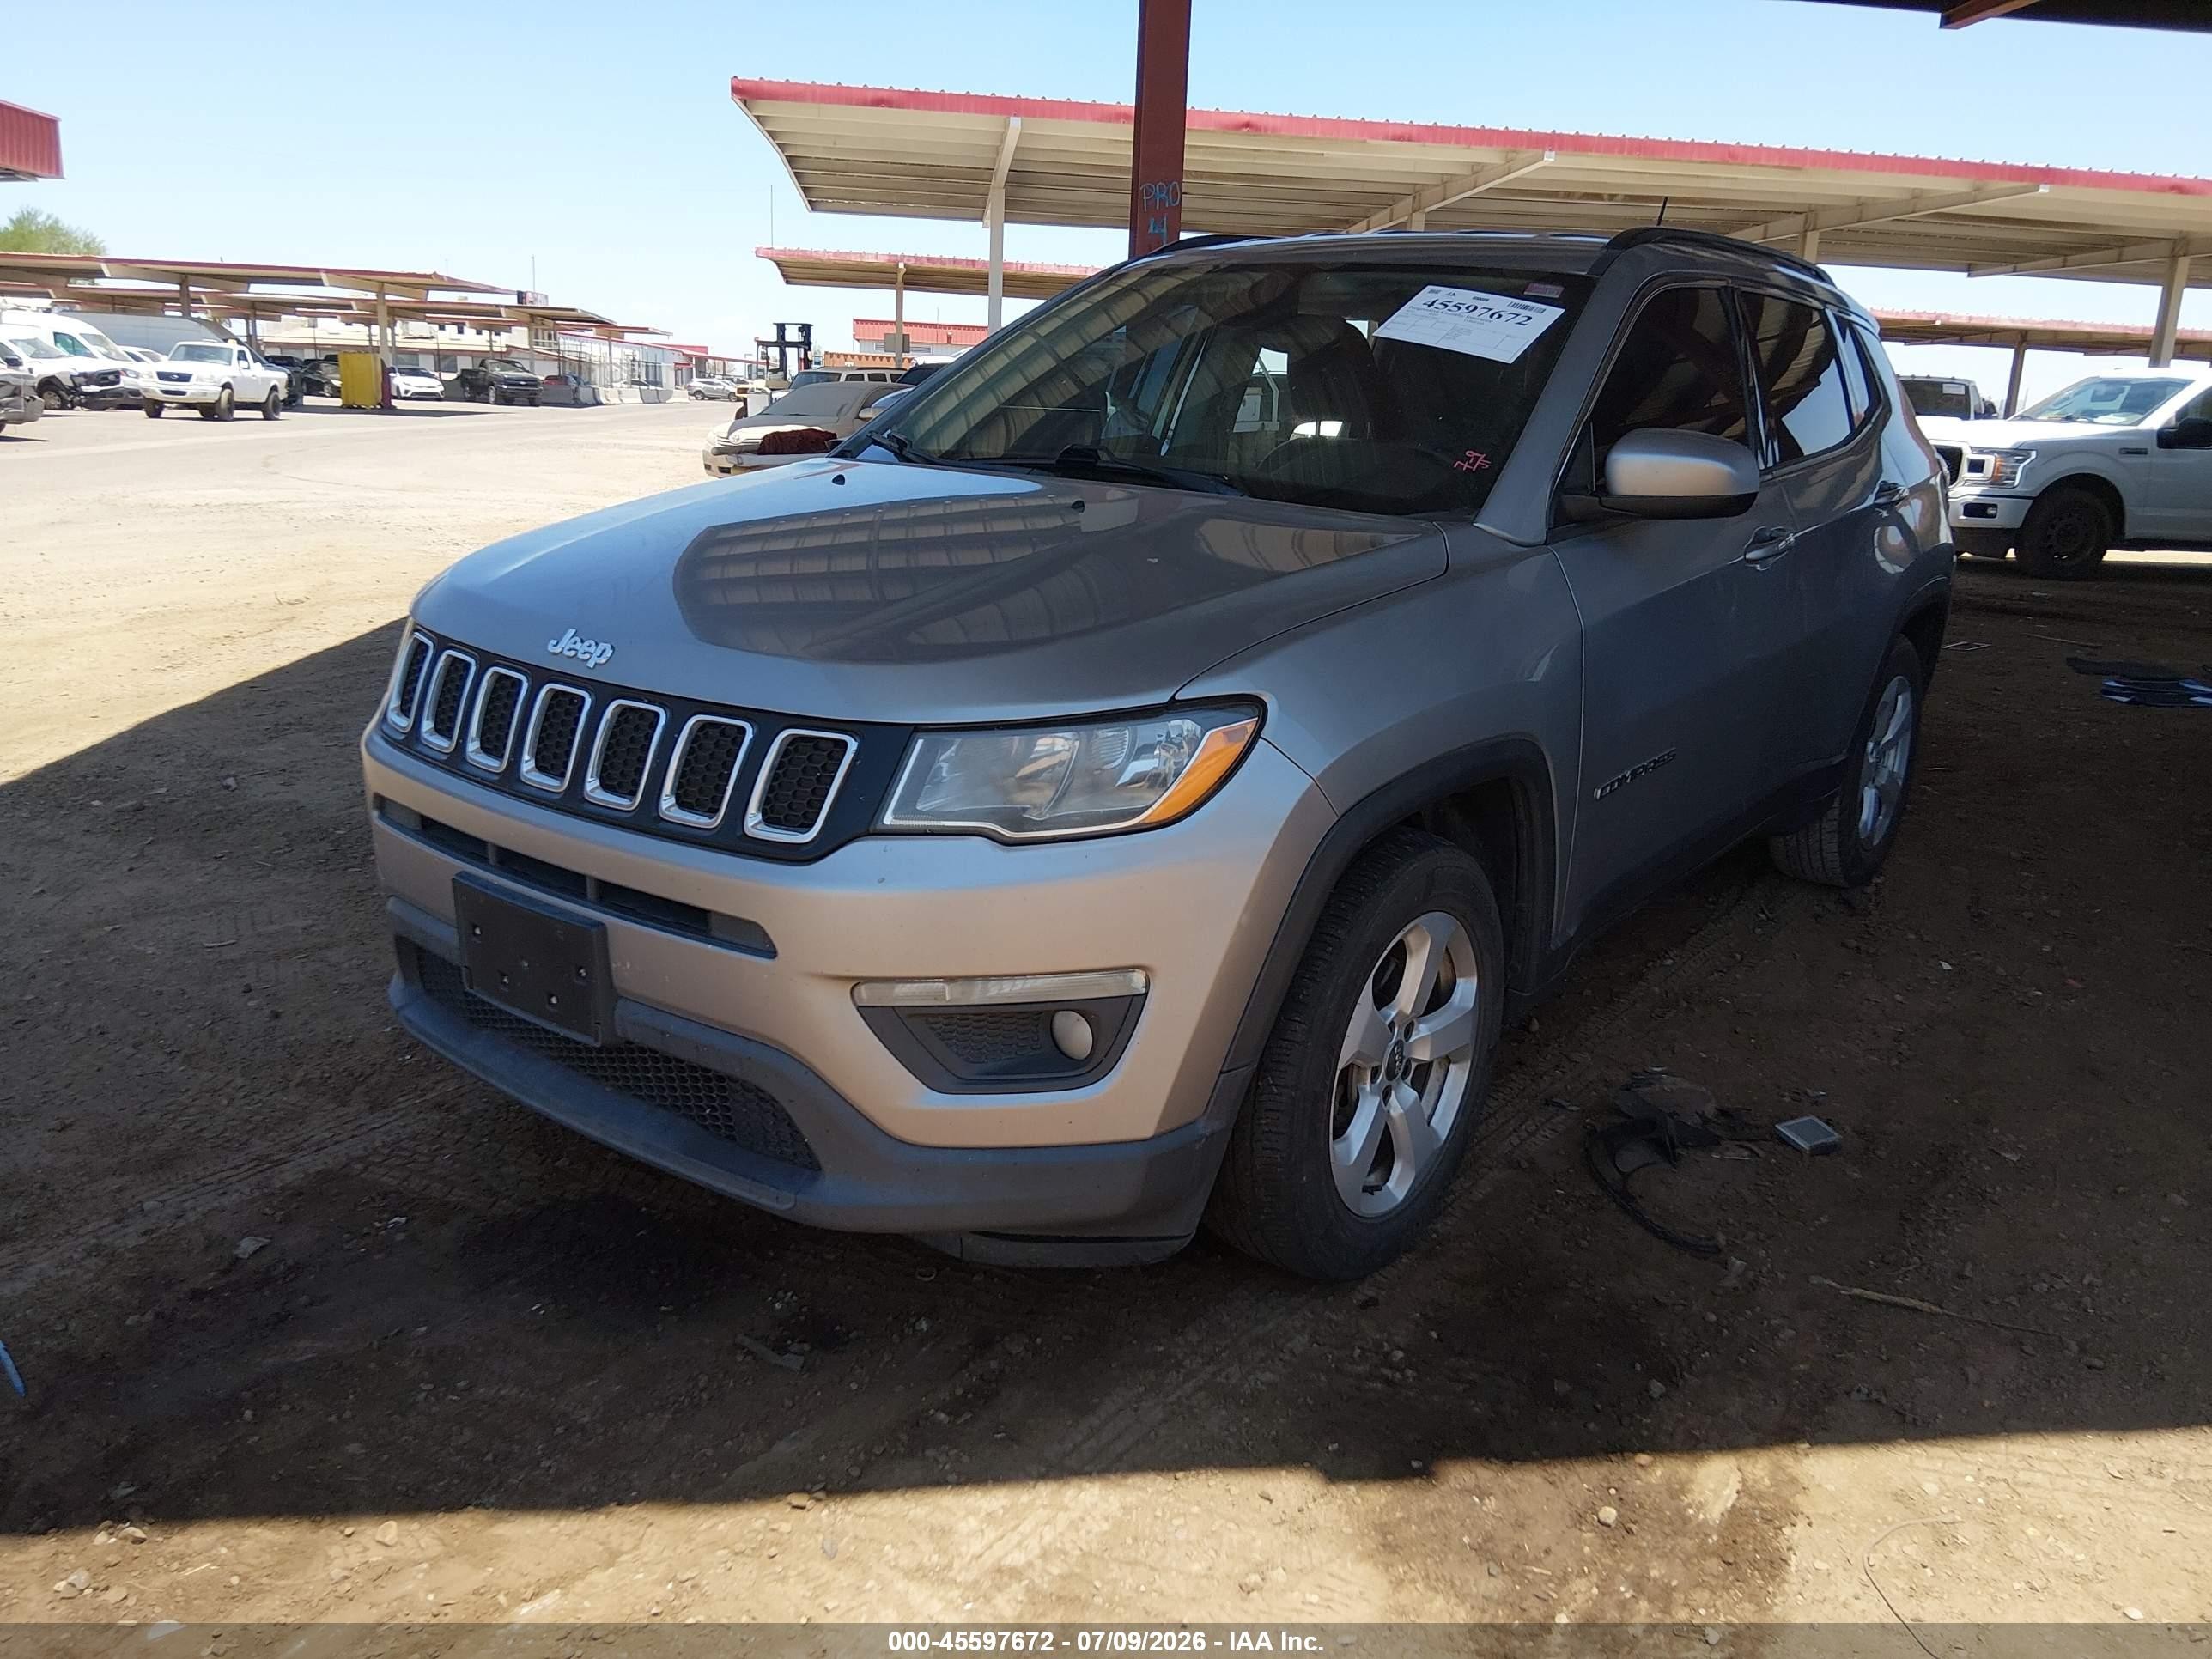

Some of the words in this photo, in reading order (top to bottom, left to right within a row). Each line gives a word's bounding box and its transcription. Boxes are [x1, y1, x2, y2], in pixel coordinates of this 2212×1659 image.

[1140, 181, 1181, 212] PRO
[1422, 298, 1534, 326] 45597672
[547, 628, 615, 669] Jeep
